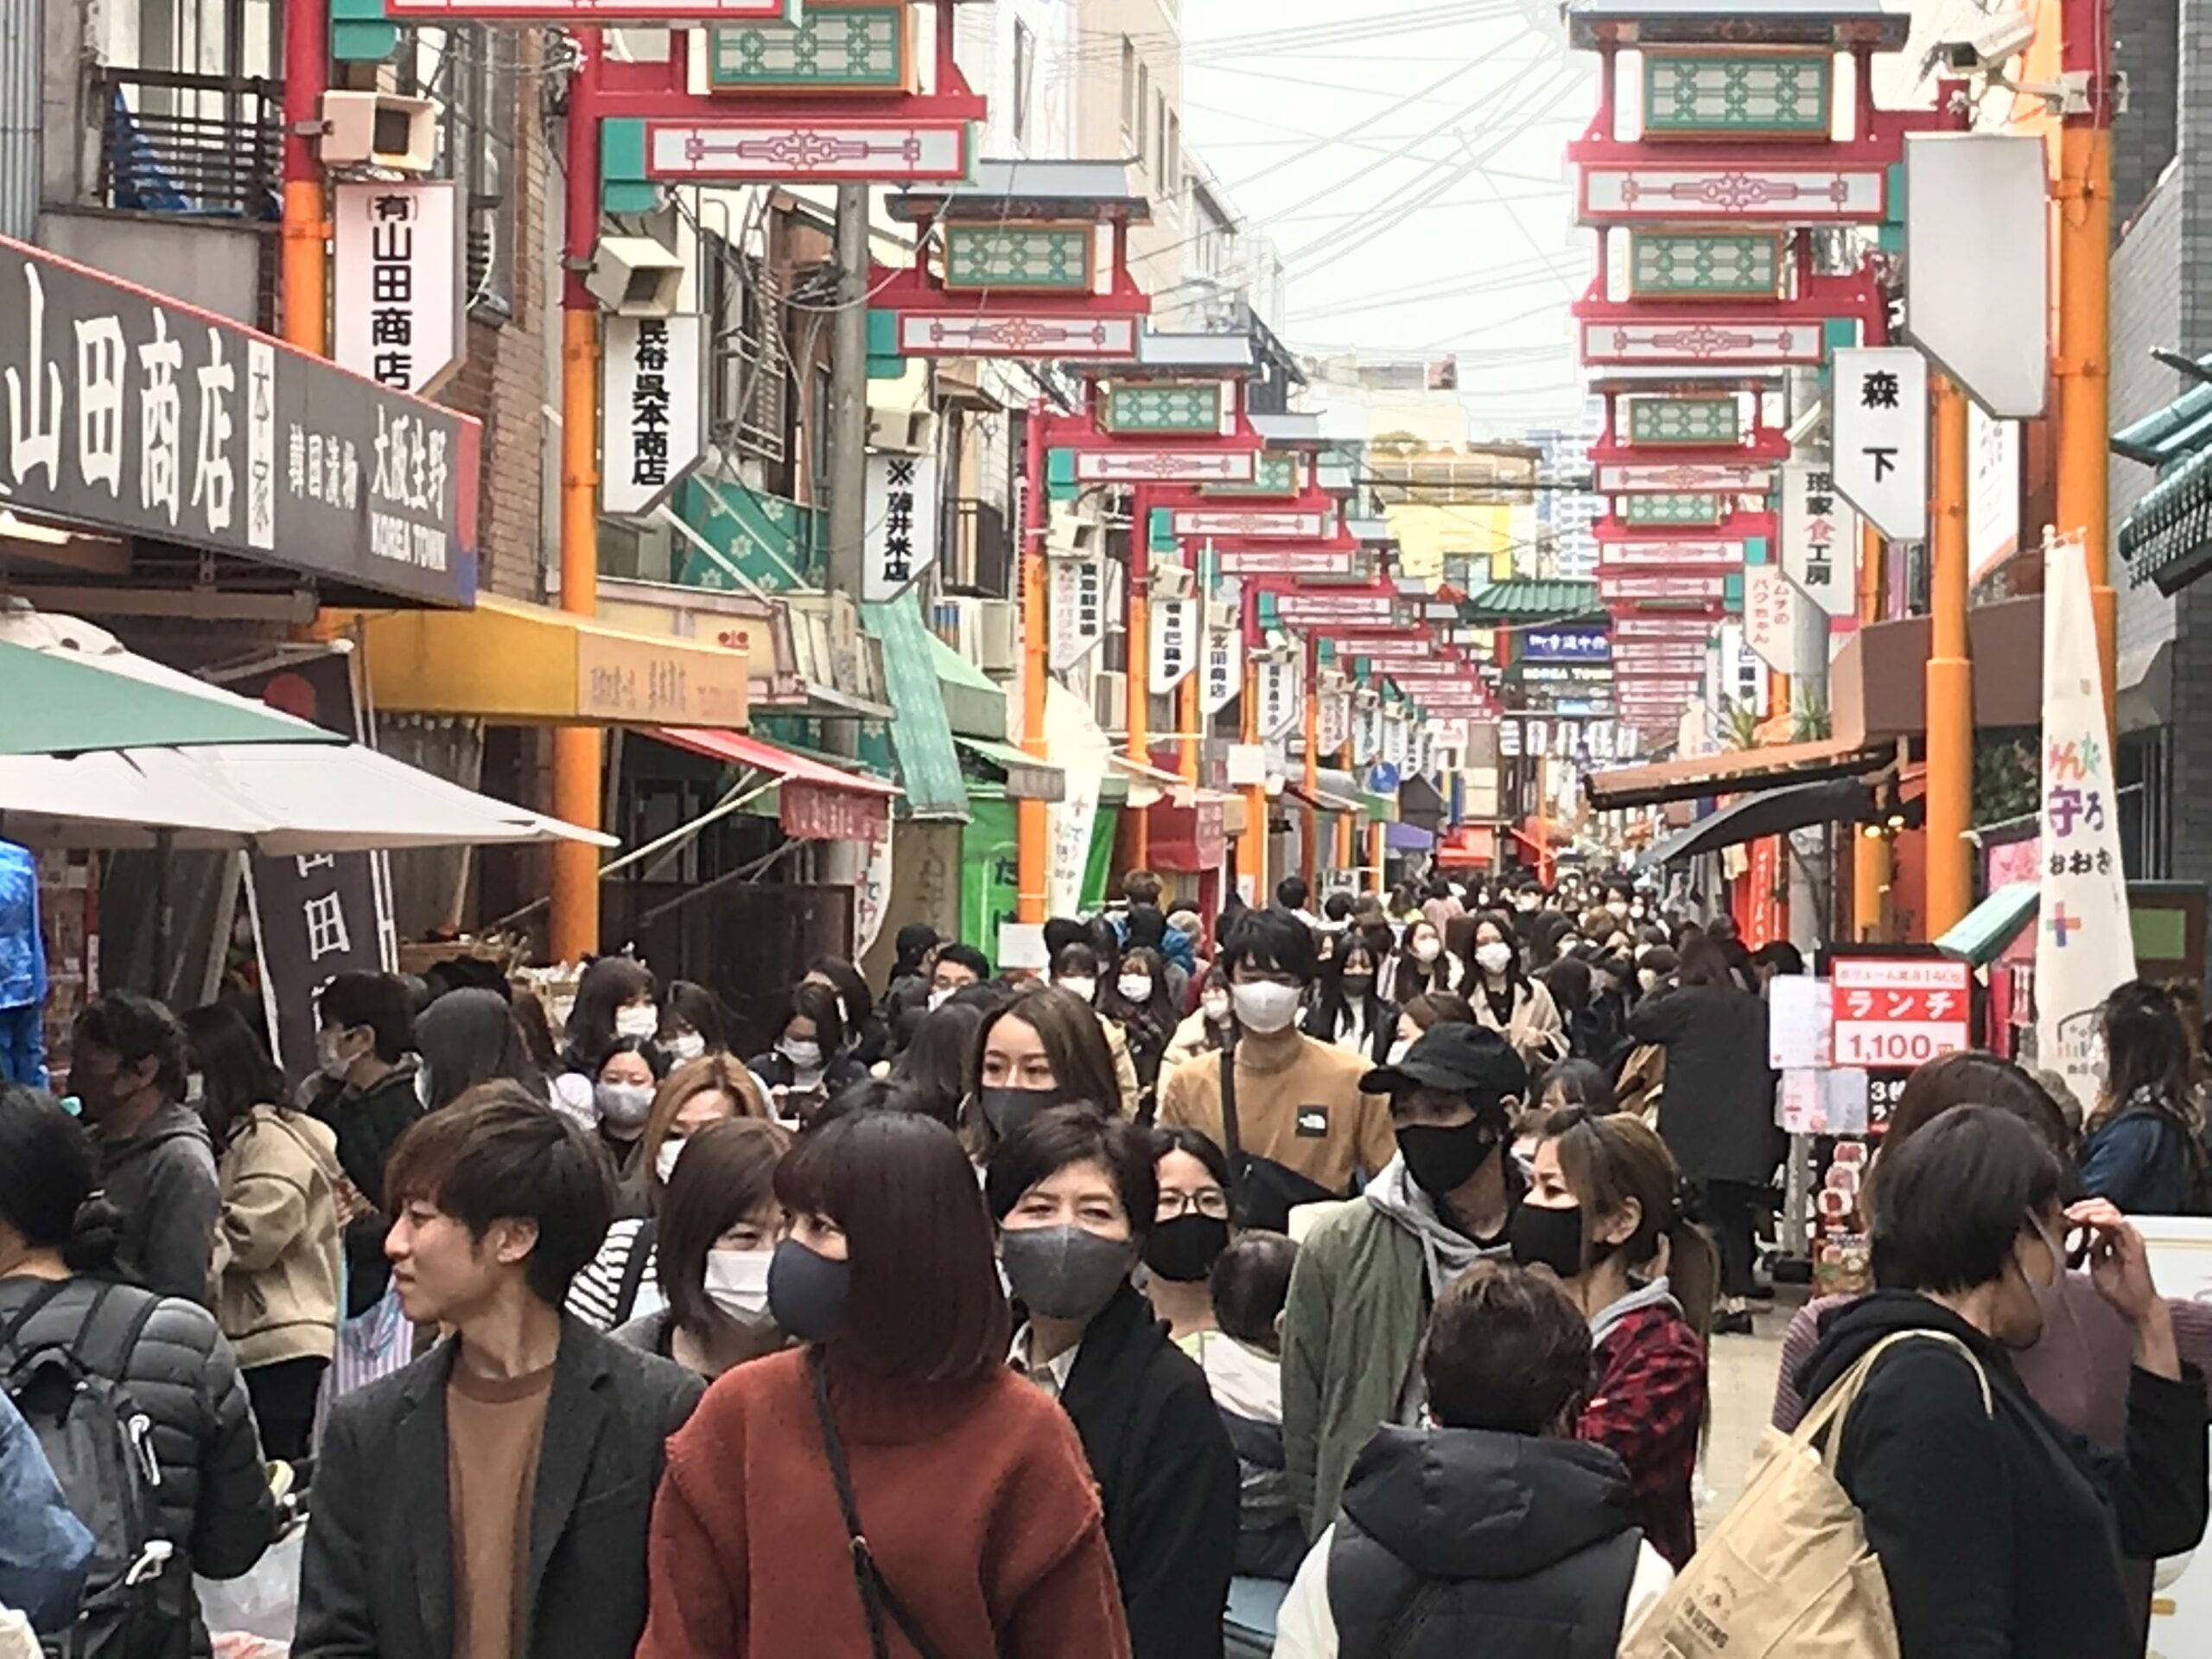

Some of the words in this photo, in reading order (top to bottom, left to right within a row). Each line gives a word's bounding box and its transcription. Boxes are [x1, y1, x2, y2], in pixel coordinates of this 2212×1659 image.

[5, 262, 235, 534] 山田商店
[1861, 371, 1900, 484] 森下
[1847, 991, 1954, 1020] ランチ
